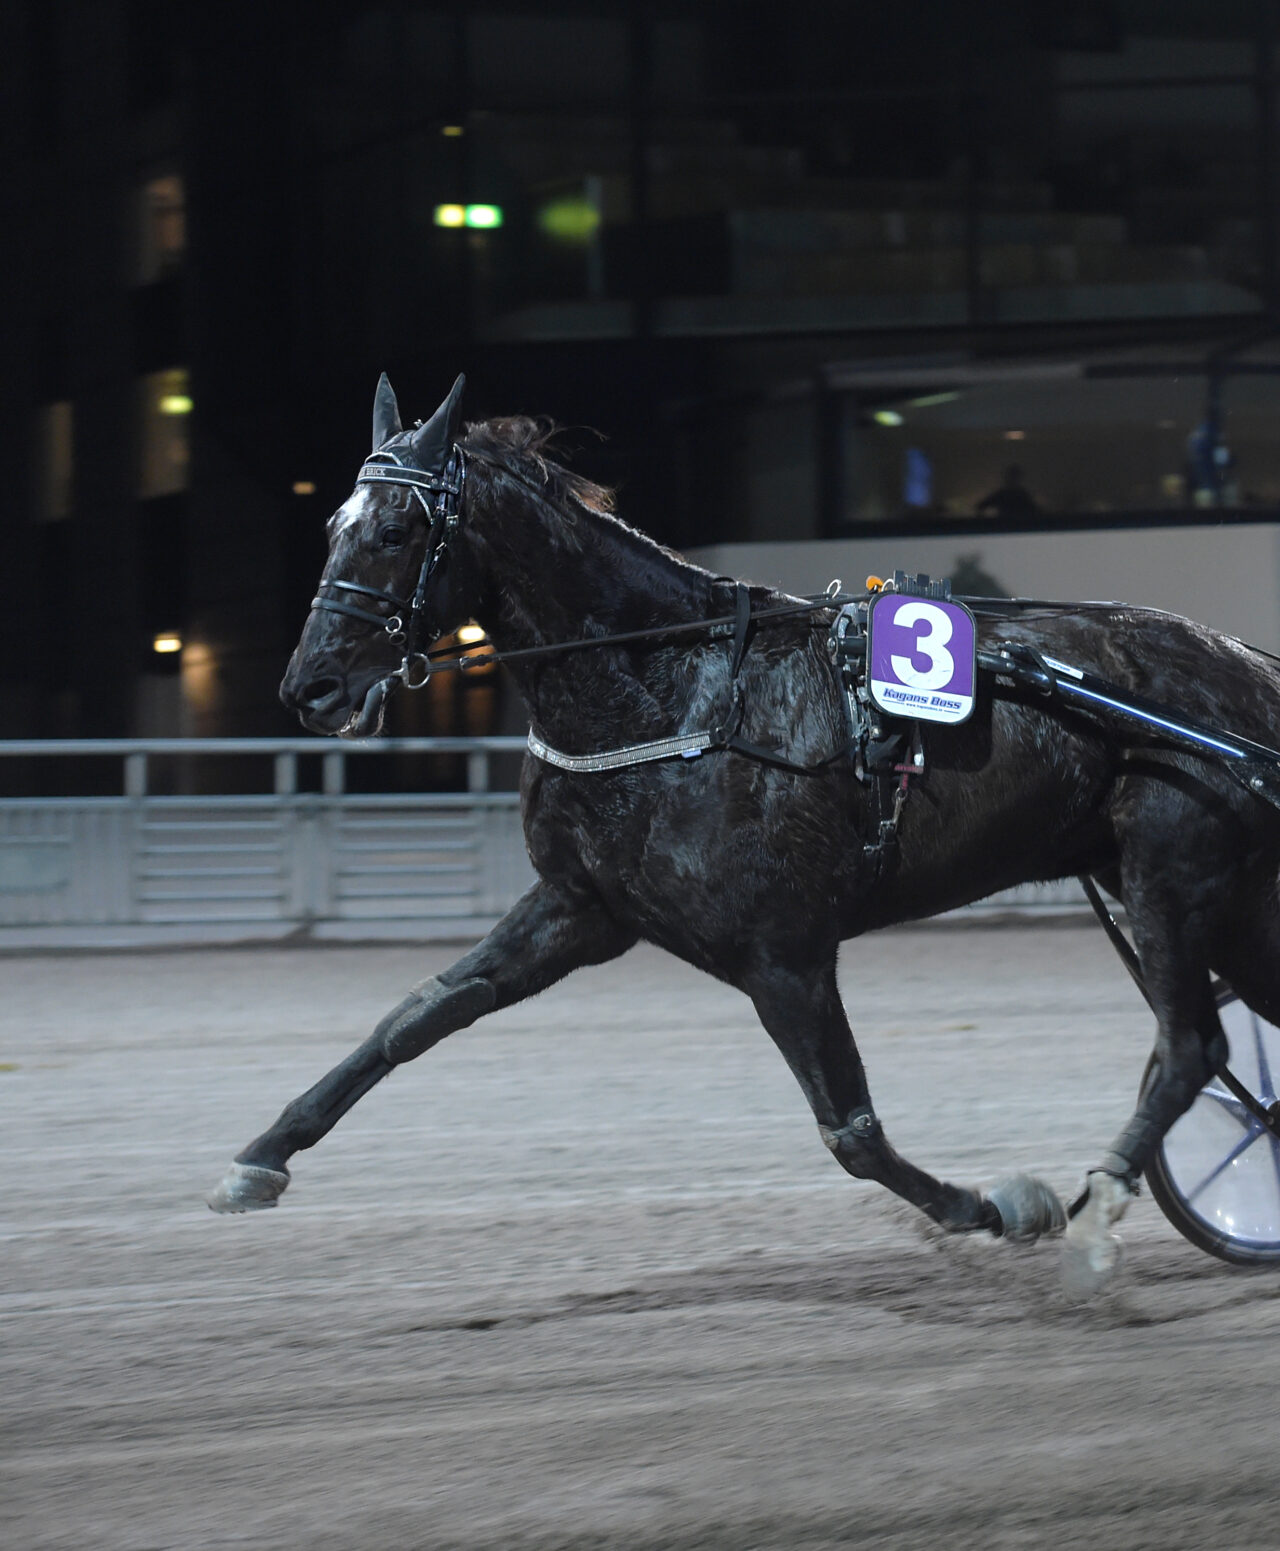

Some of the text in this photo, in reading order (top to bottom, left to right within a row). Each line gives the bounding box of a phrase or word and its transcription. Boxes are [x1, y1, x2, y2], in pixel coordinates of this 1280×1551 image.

[890, 602, 955, 690] 3
[883, 687, 929, 704] Kagans
[930, 695, 962, 709] Boss
